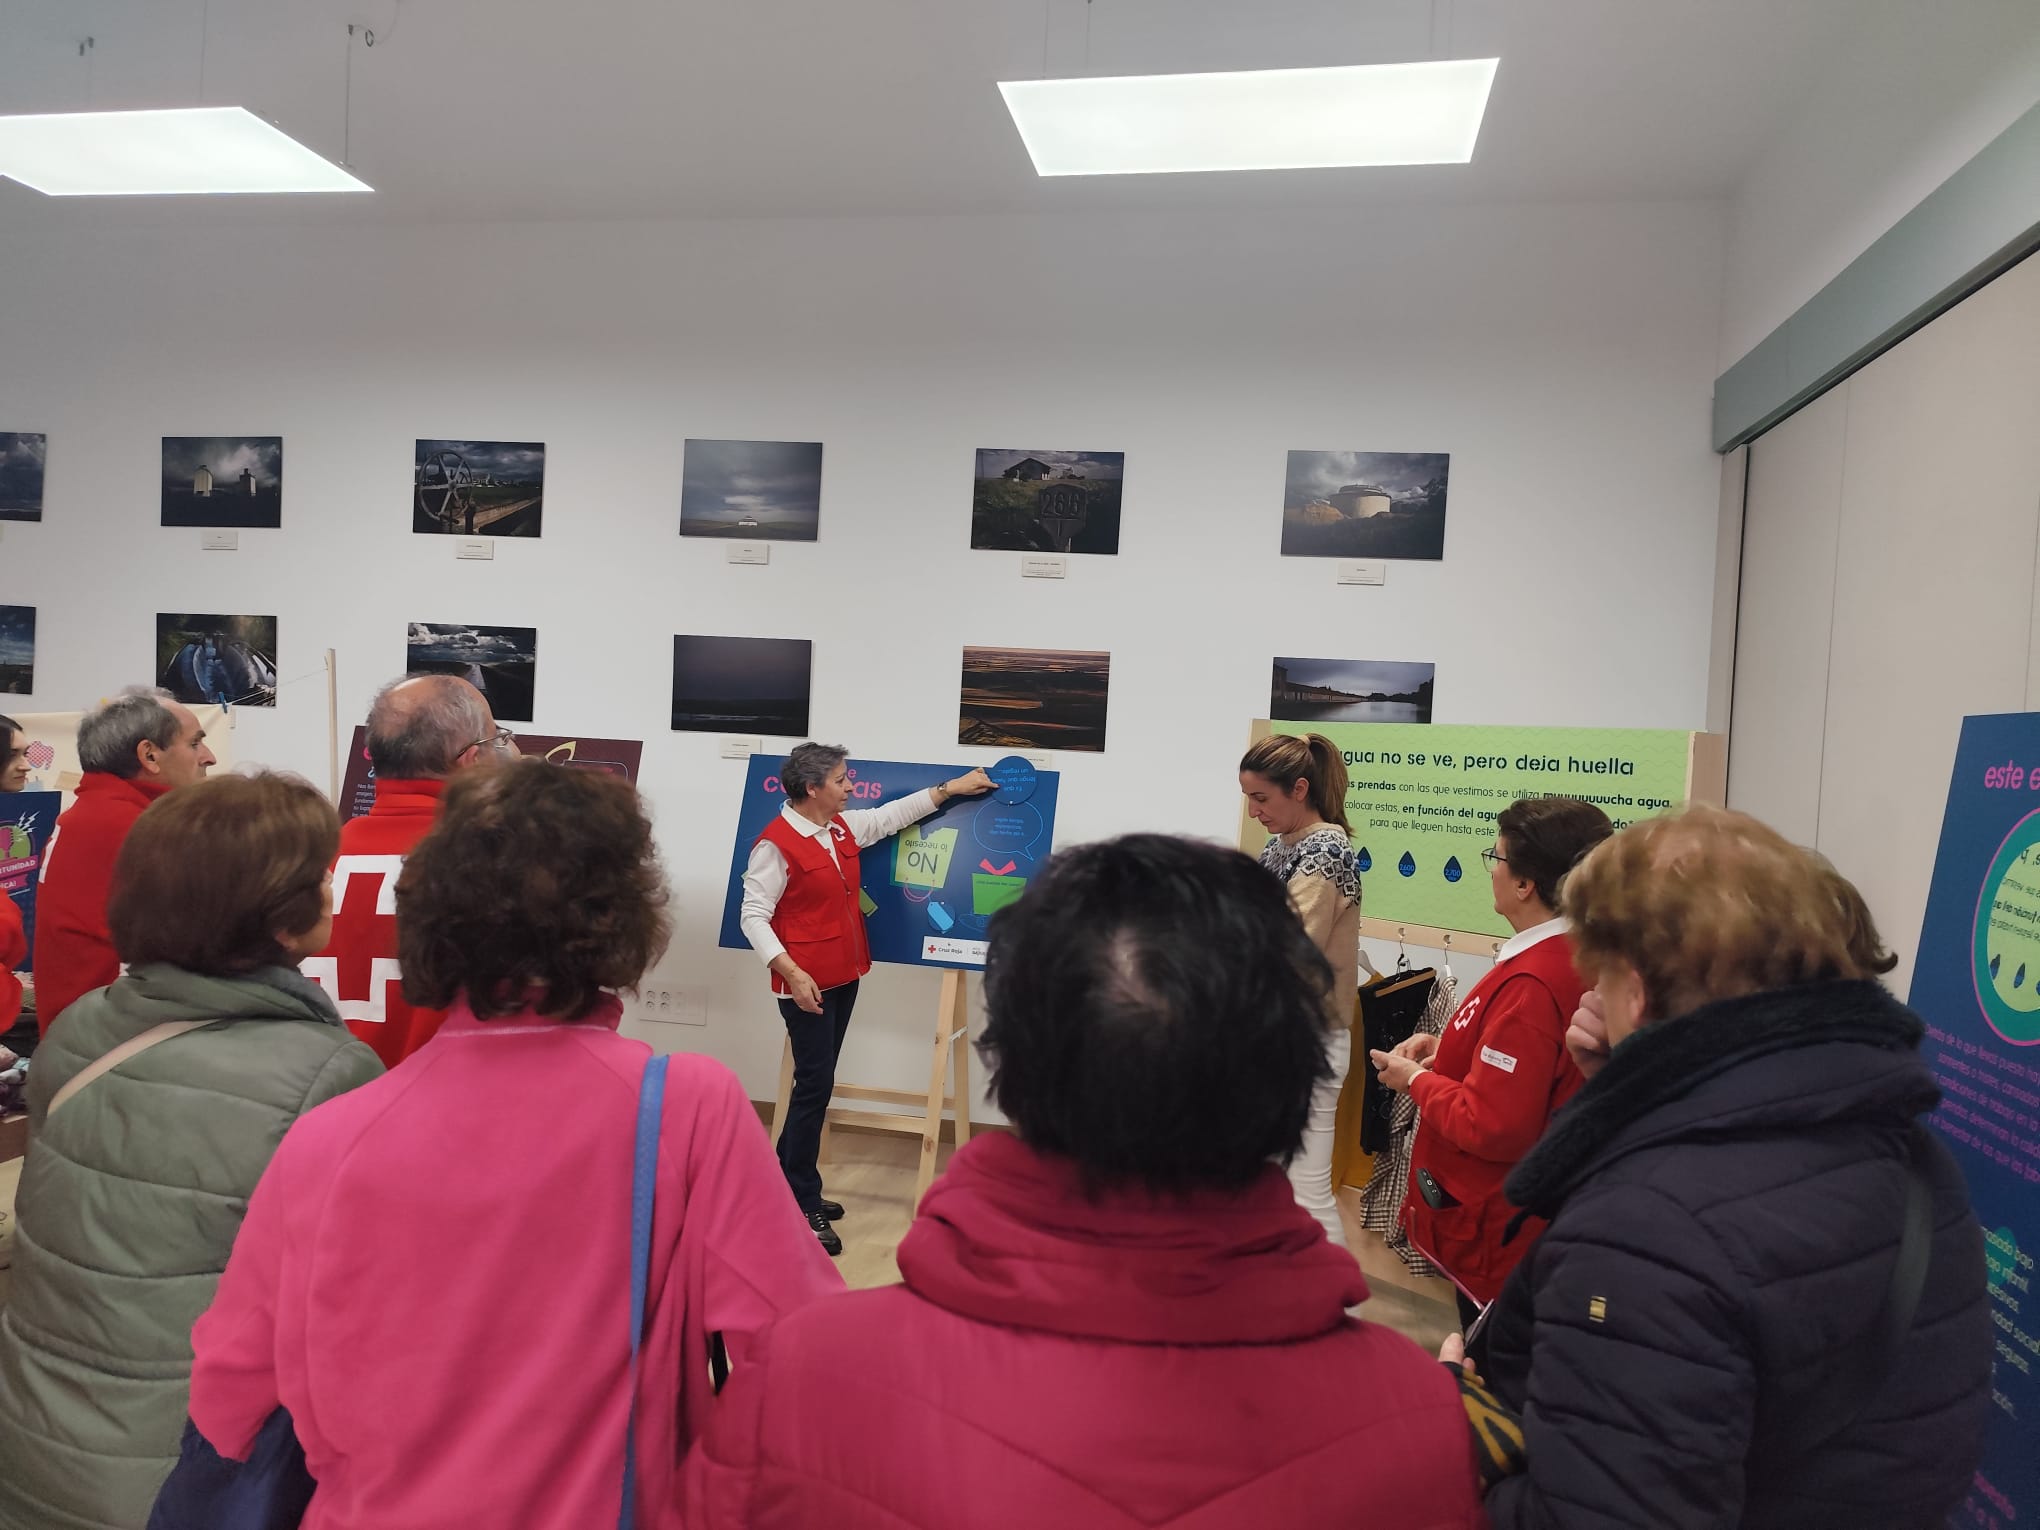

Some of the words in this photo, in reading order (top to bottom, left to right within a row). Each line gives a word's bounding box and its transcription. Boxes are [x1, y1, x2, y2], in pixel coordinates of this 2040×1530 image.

[1340, 750, 1374, 766] gua
[1381, 752, 1401, 764] no
[1407, 753, 1426, 766] se
[1433, 754, 1457, 769] ve,
[1464, 755, 1507, 771] pero
[1515, 754, 1560, 772] deja
[1568, 756, 1634, 775] huella
[1984, 760, 2024, 790] este
[1357, 780, 1396, 791] prendas
[1399, 783, 1414, 792] con
[1418, 782, 1430, 793] las
[1433, 785, 1450, 797] que
[1453, 785, 1494, 798] vestimos
[1497, 788, 1508, 798] se
[1637, 797, 1673, 810] agua.
[1344, 800, 1373, 811] colocar
[1375, 803, 1400, 815] estas,
[1402, 805, 1415, 814] en
[1418, 805, 1455, 818] función
[1458, 808, 1474, 819] del
[1477, 812, 1498, 822] agu
[1370, 818, 1390, 828] para
[1392, 820, 1409, 831] que
[1411, 820, 1443, 833] lleguen
[1446, 823, 1472, 835] hasta
[1475, 827, 1496, 837] este
[904, 839, 938, 850] necesito
[907, 852, 939, 875] No
